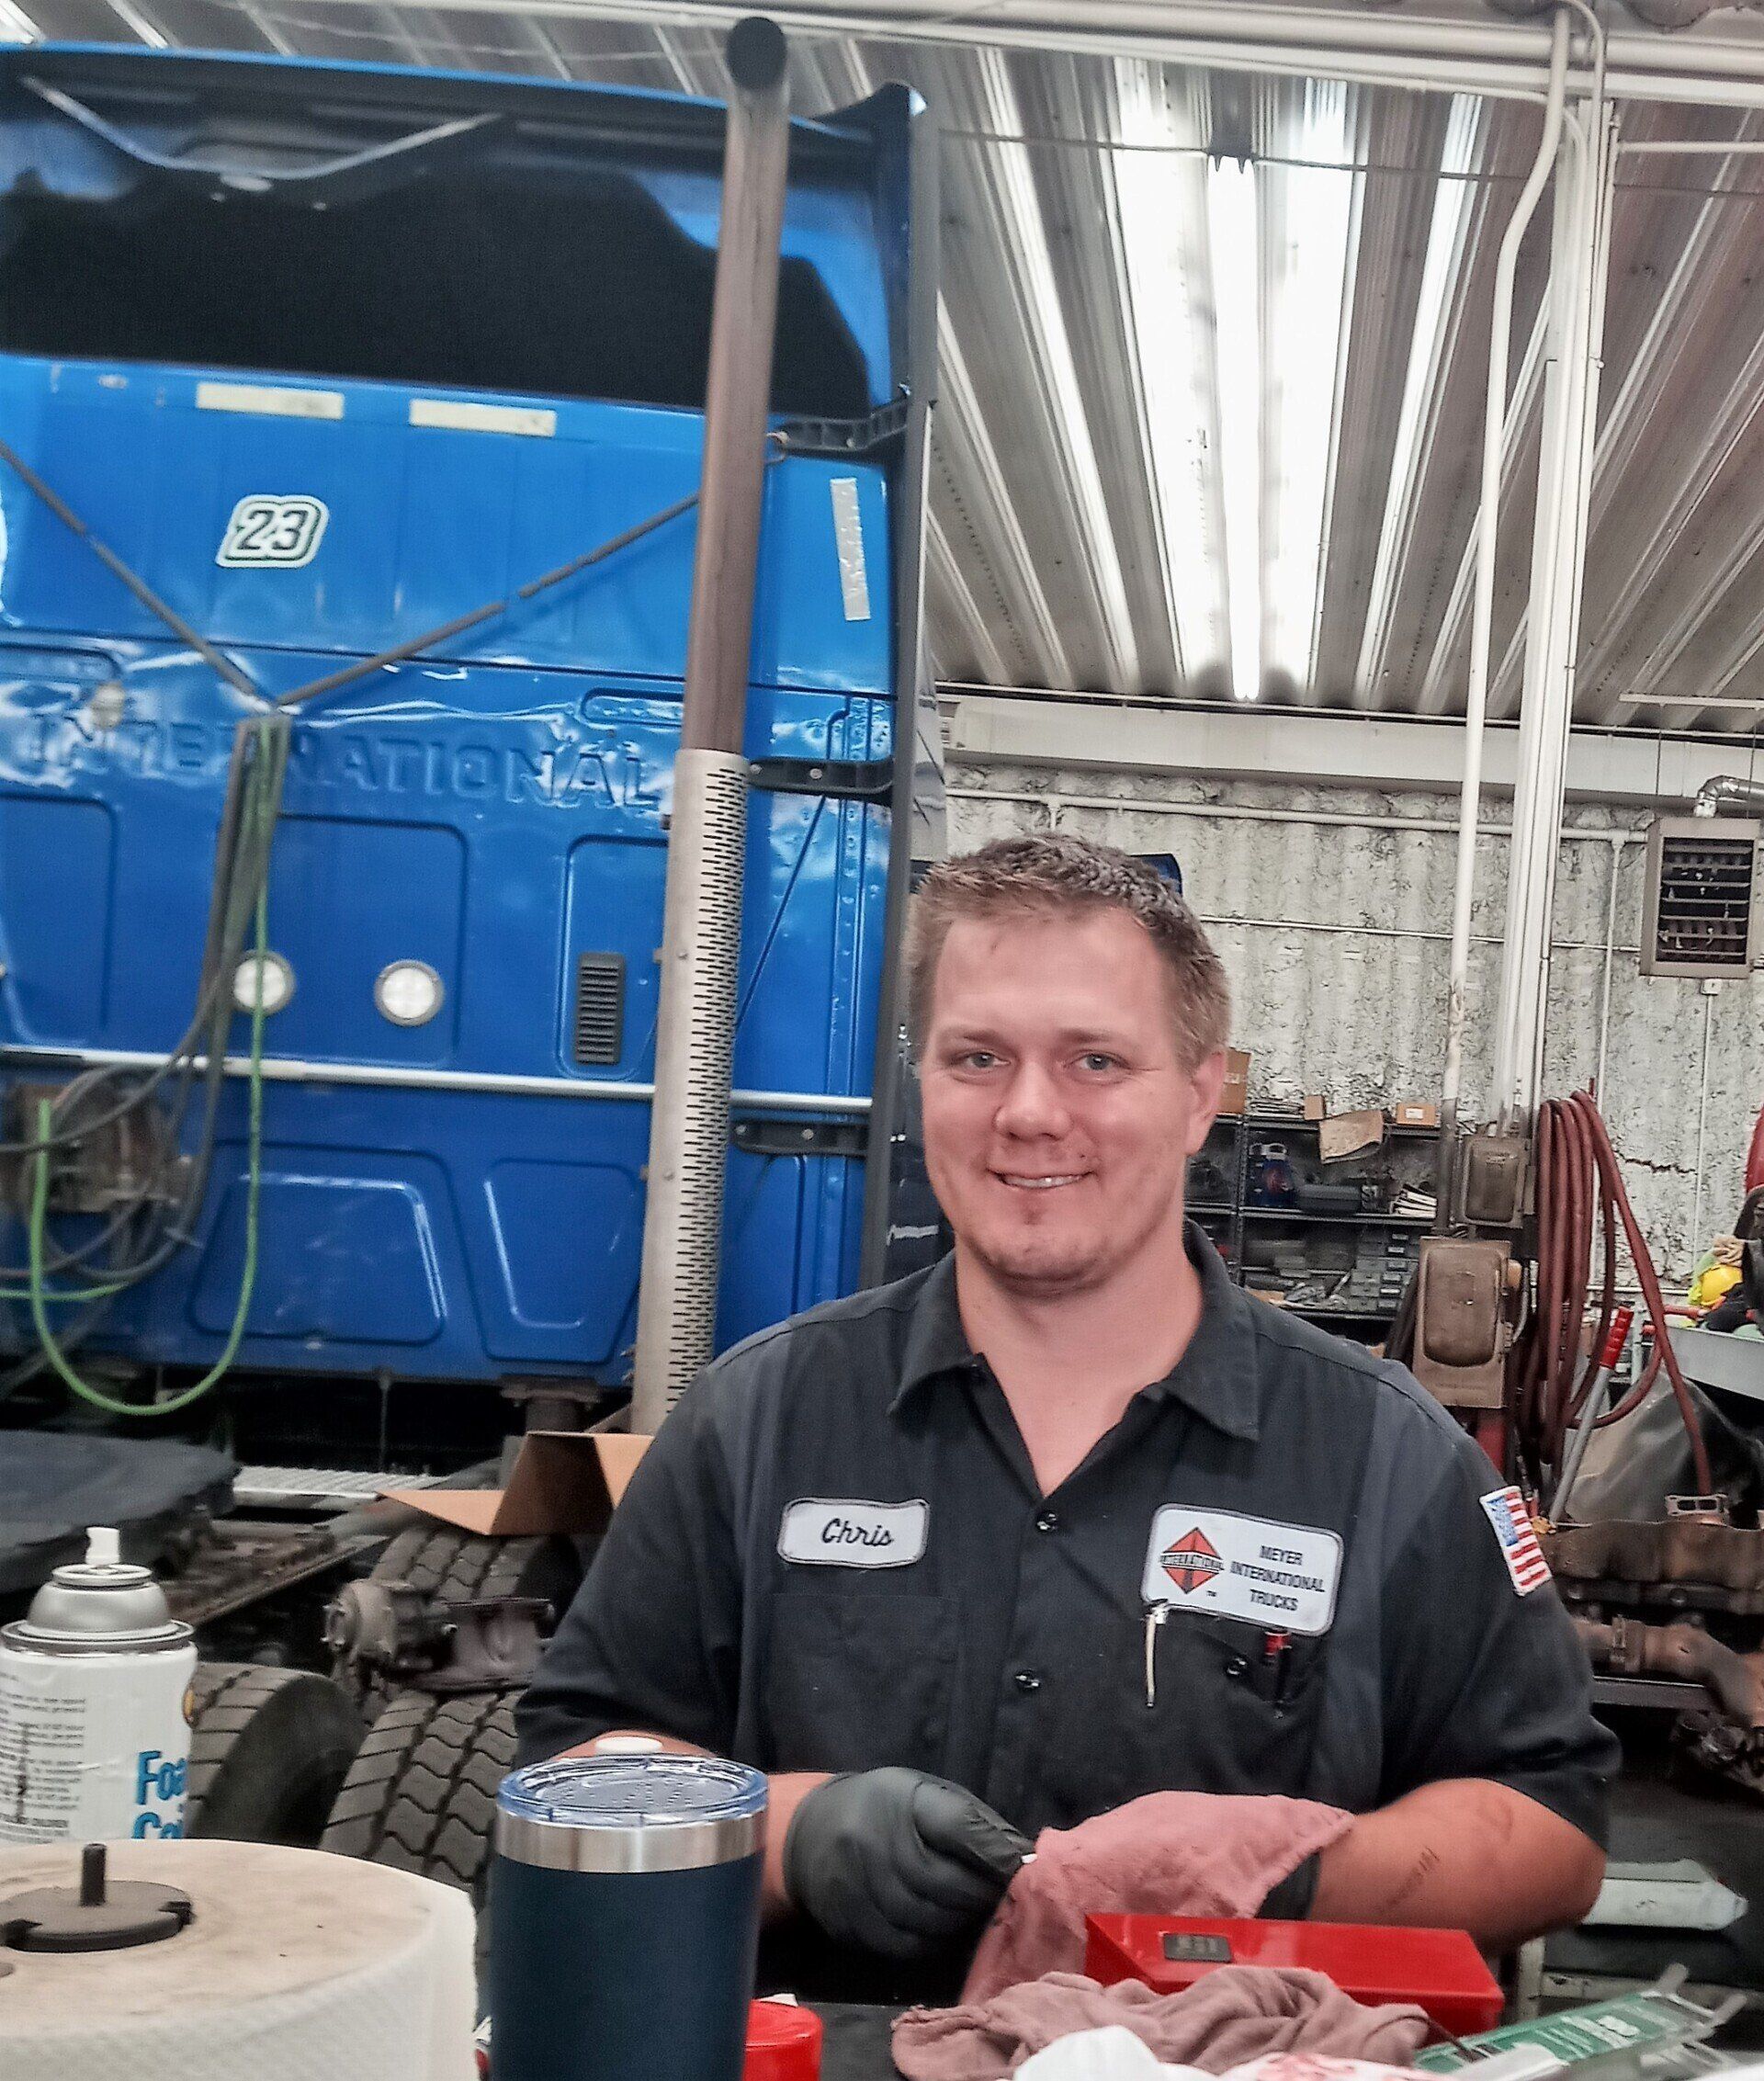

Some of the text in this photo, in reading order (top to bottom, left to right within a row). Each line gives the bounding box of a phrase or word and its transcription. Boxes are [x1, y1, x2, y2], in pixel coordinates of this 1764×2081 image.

[237, 509, 309, 550] 23
[821, 1518, 894, 1546] Chris
[1260, 1544, 1303, 1566] MEYER
[1229, 1561, 1326, 1592] INTERNATIONAL
[1250, 1589, 1298, 1611] TRUCKS
